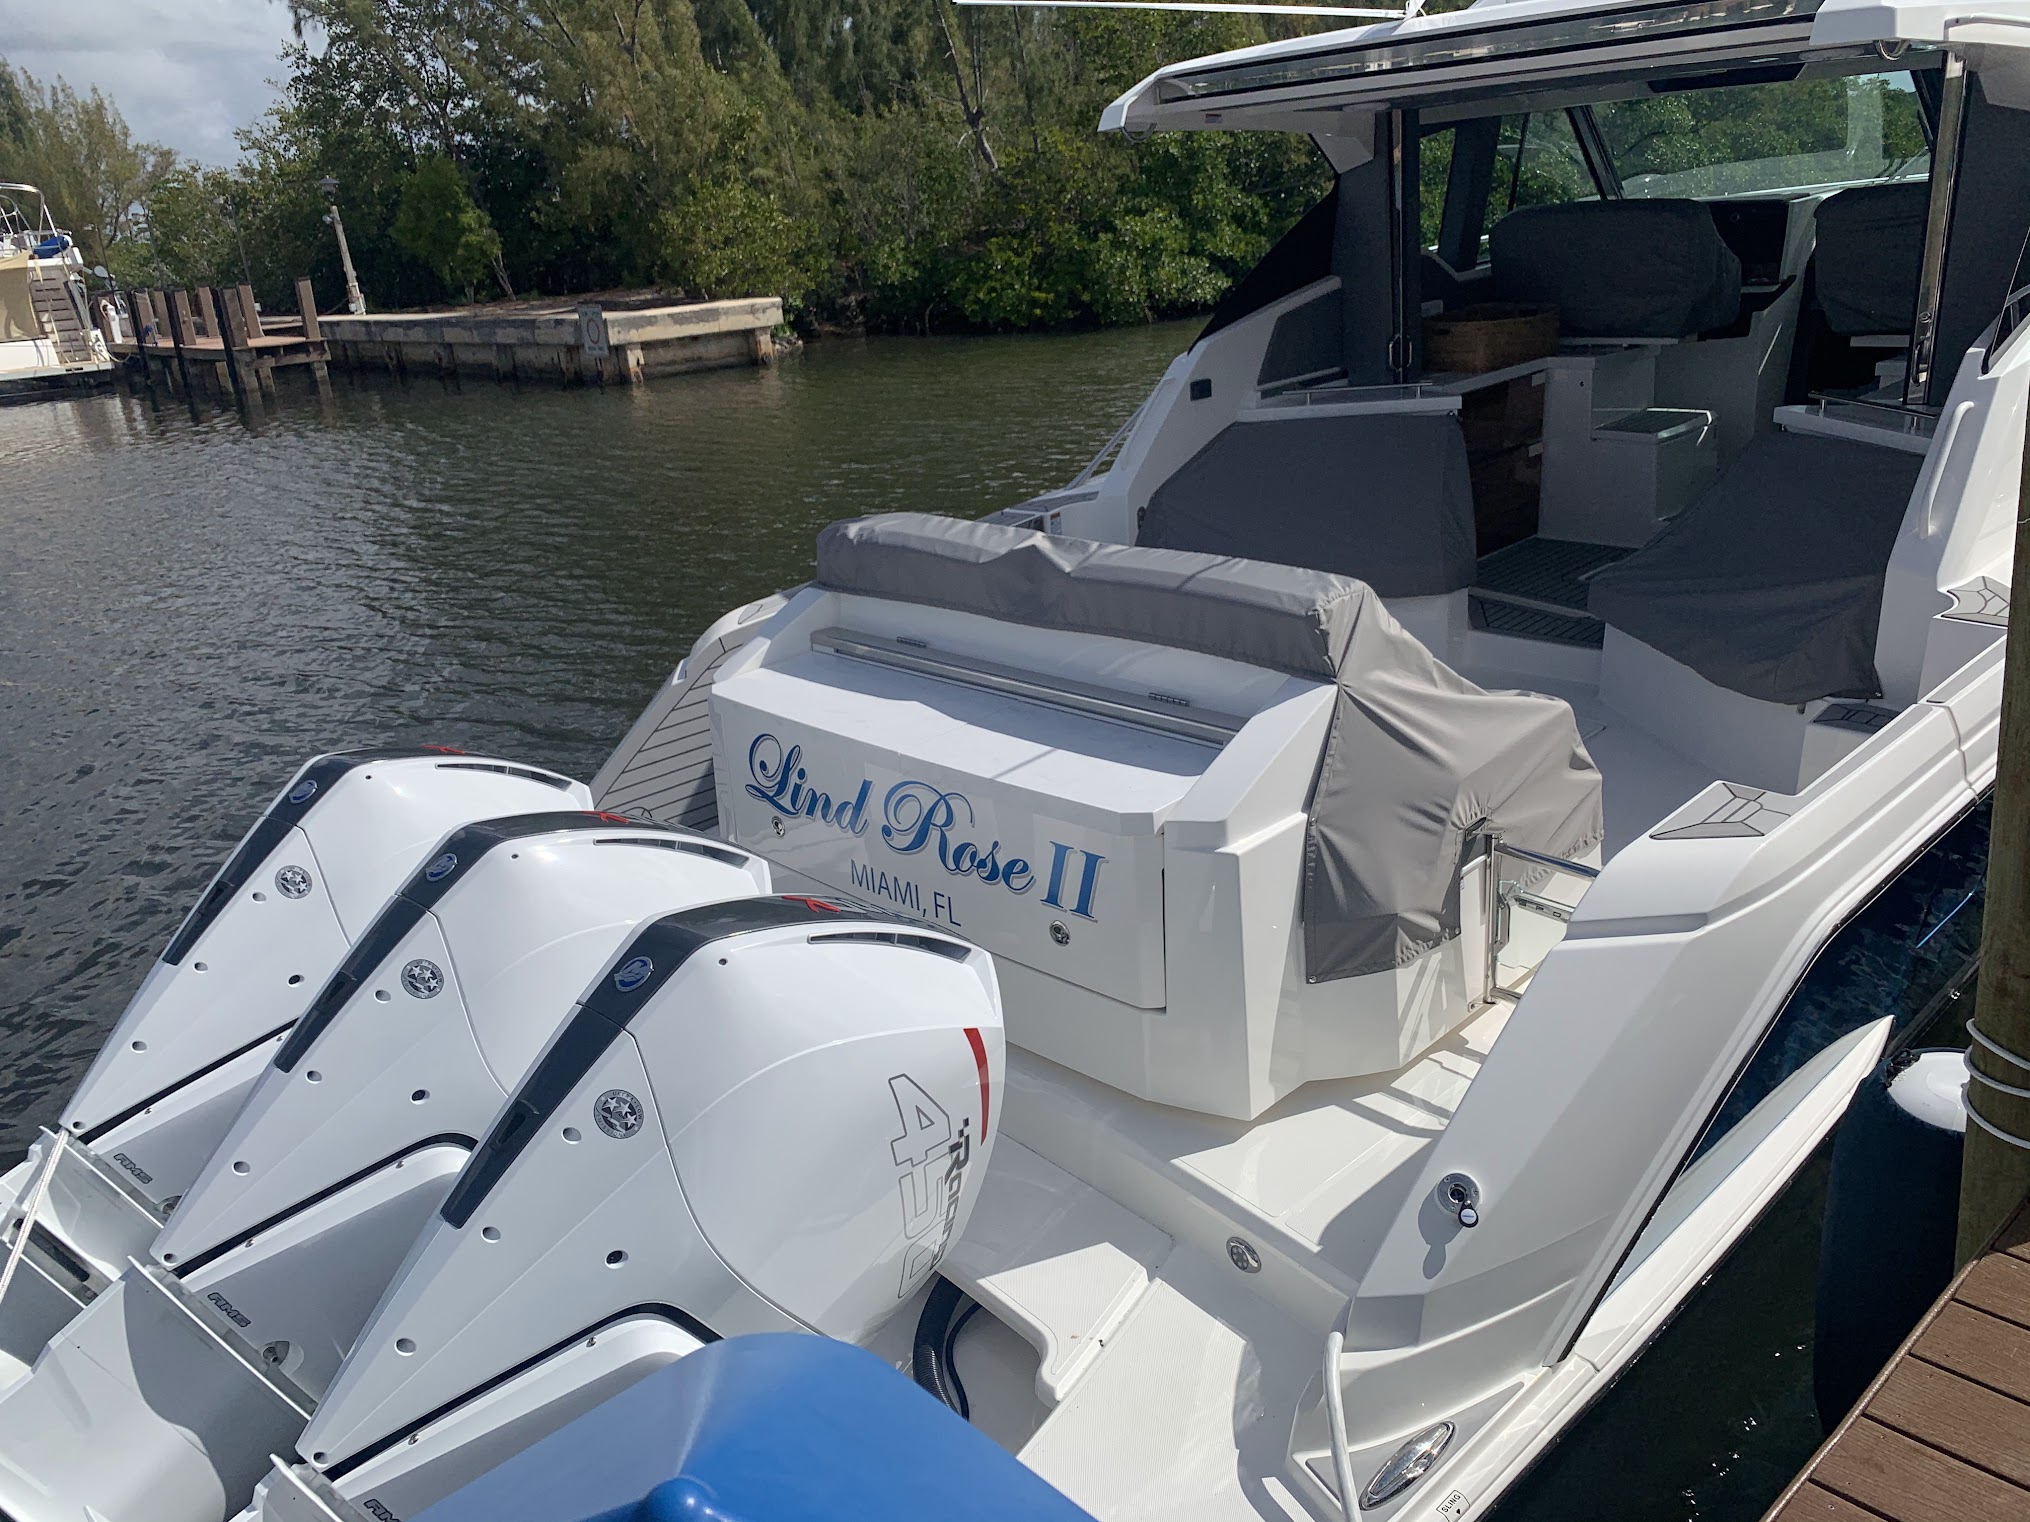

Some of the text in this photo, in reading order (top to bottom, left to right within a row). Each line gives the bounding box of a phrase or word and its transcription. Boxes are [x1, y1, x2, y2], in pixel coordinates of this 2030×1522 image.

[745, 733, 1107, 919] Lind Rose II
[850, 859, 962, 927] MIAMI, FL
[1441, 1494, 1461, 1513] SLING
